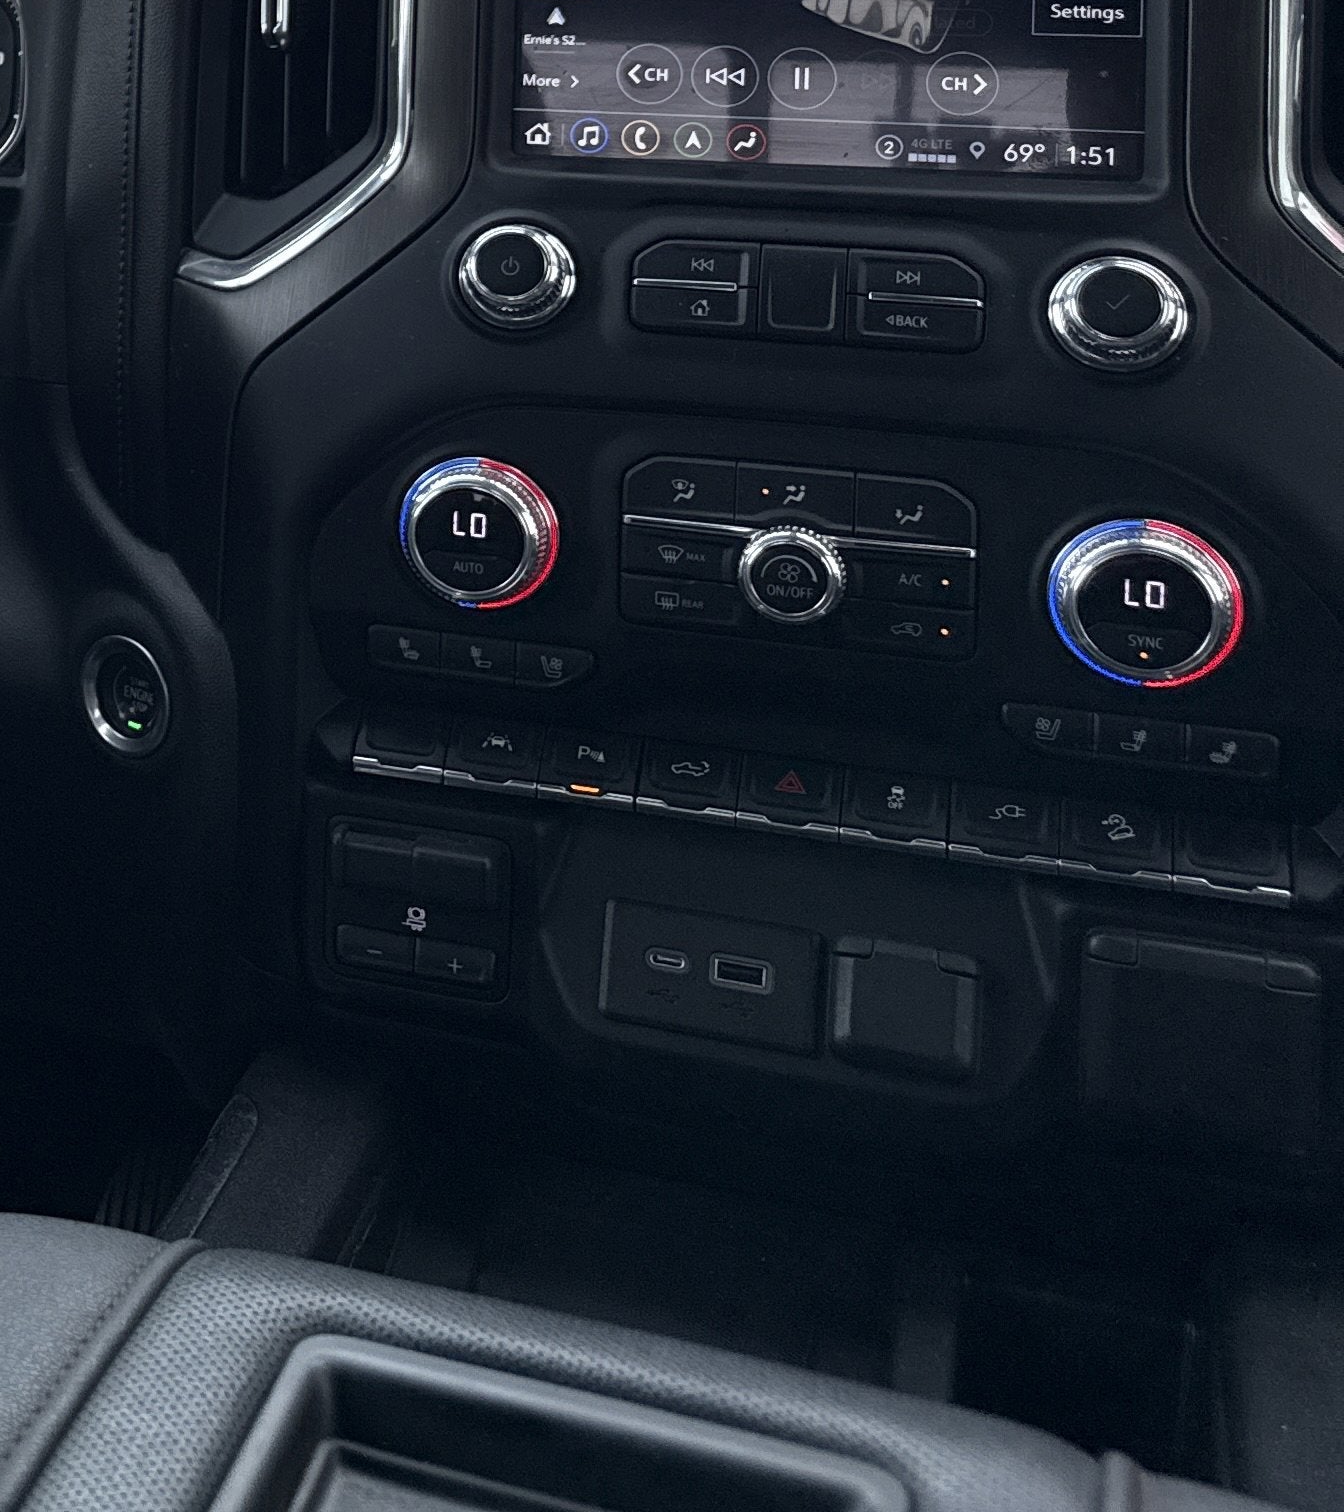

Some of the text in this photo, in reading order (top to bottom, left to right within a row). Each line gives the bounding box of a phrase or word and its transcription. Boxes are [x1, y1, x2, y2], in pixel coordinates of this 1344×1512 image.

[1050, 3, 1124, 23] Settings
[522, 74, 560, 87] More
[644, 68, 669, 82] CH
[941, 77, 967, 91] CH
[883, 141, 894, 154] 2
[911, 139, 952, 150] 4G LTE
[1003, 143, 1115, 166] 69° 1:51
[895, 315, 928, 328] BACK
[452, 510, 487, 538] LO
[685, 552, 706, 563] MAX
[453, 561, 484, 575] AUTO
[898, 573, 922, 587] A/C
[766, 583, 814, 599] ON/OFF
[1124, 578, 1166, 609] LO
[681, 599, 705, 610] REAR
[1127, 634, 1164, 650] SYNC
